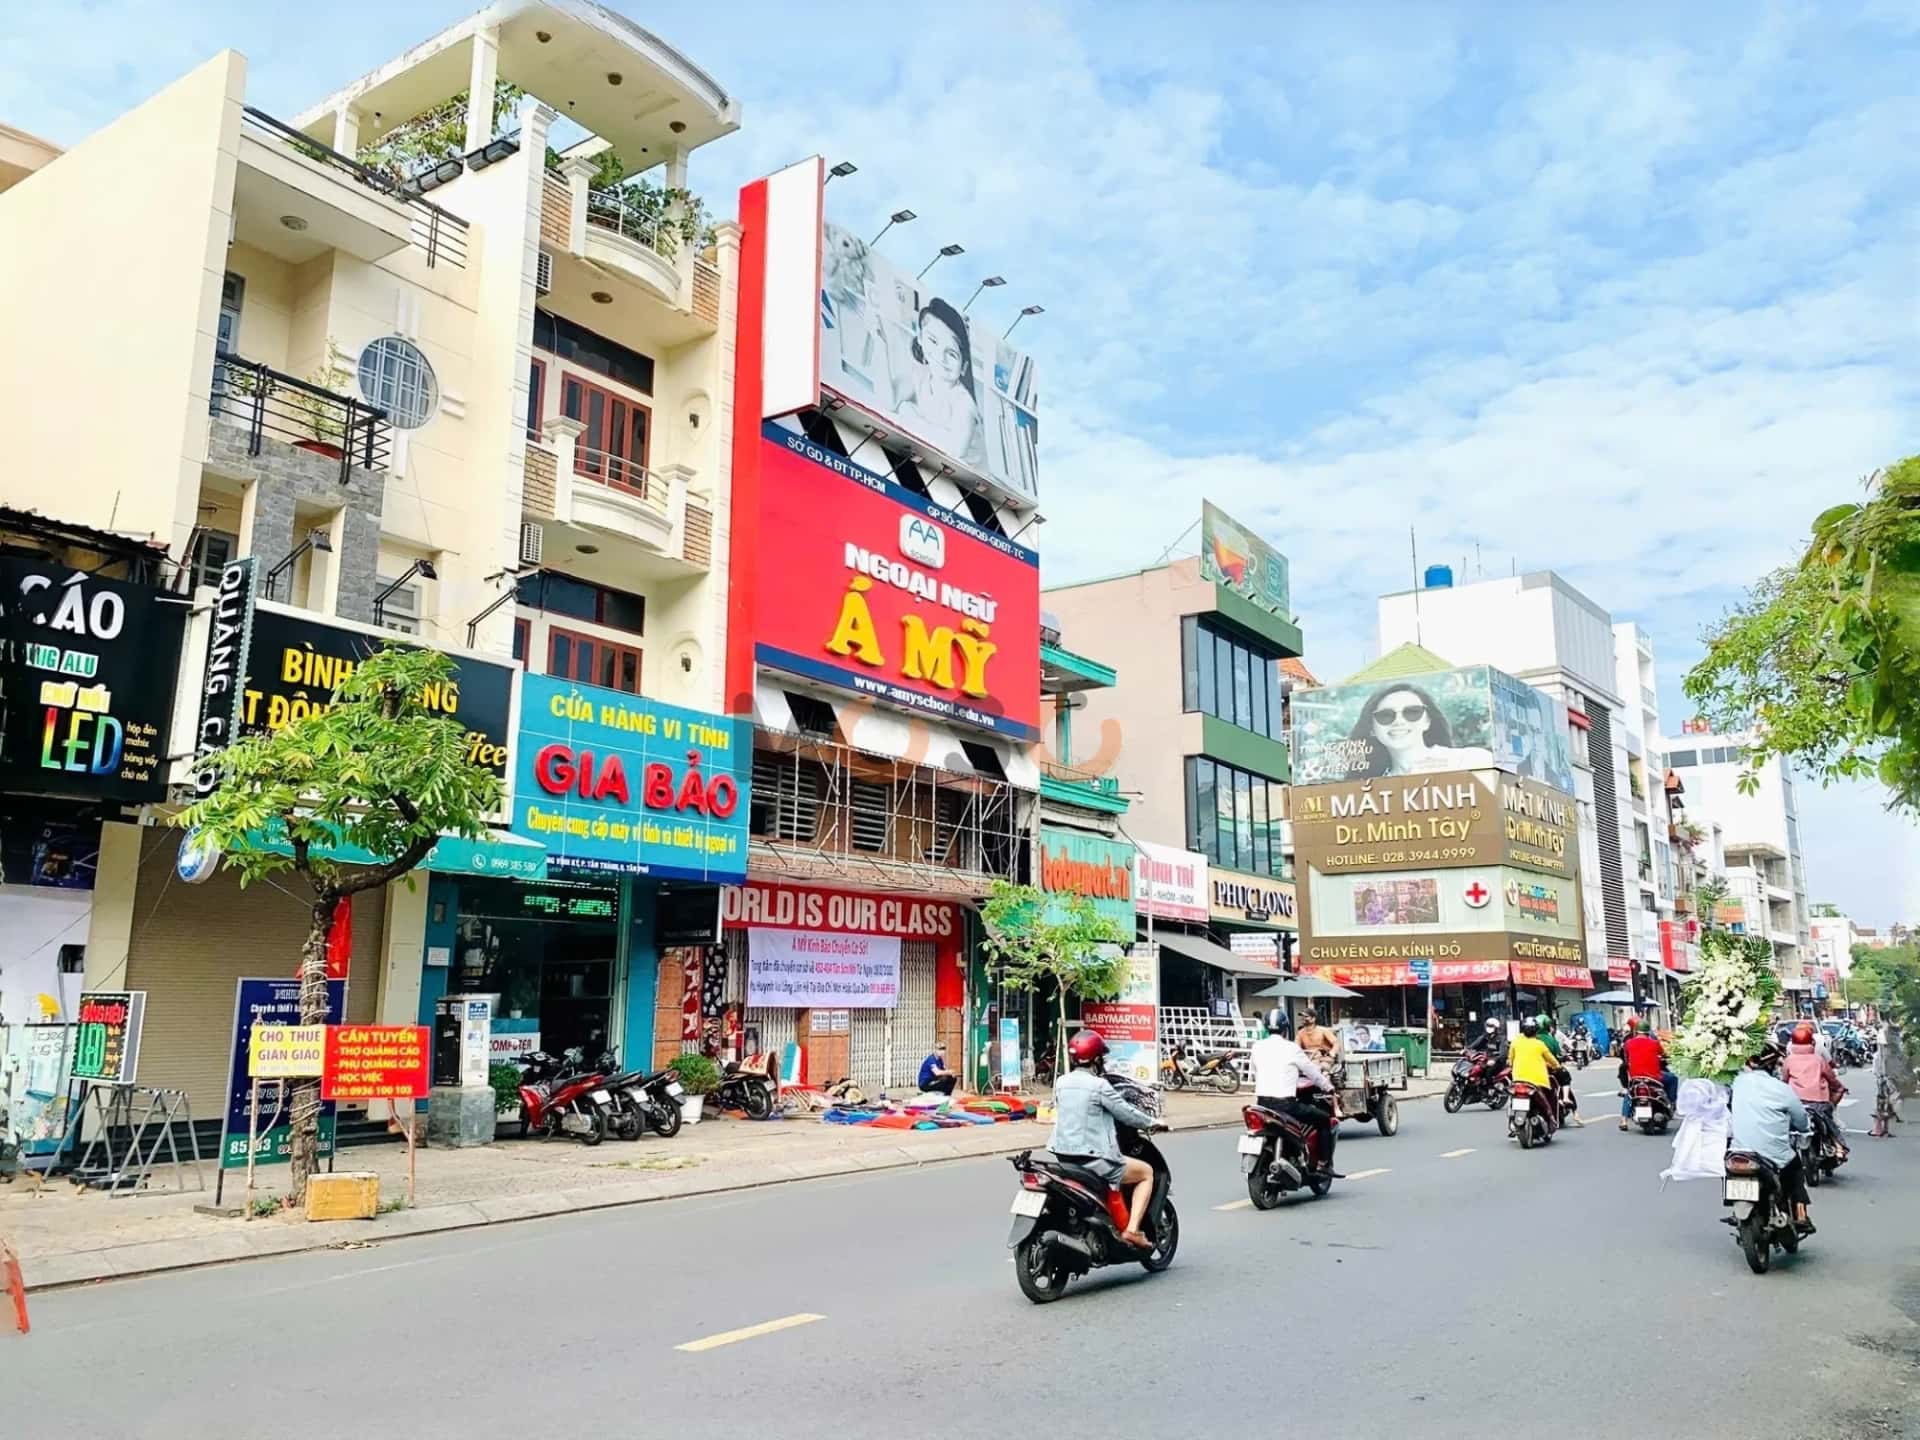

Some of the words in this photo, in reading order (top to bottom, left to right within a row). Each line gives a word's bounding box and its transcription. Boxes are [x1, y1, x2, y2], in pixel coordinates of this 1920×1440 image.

[806, 446, 823, 462] GD
[824, 456, 832, 468] &
[833, 461, 848, 474] ĐT
[849, 467, 887, 494] TP.HCM
[844, 542, 938, 604] NGOẠI
[940, 590, 998, 624] NGỮ
[207, 564, 243, 696] QUẢNG
[59, 649, 99, 678] ALU
[283, 641, 355, 690] BÌNH
[900, 614, 998, 698] MỸ
[550, 688, 594, 724] CỬA
[600, 702, 657, 737] HÀNG
[662, 720, 681, 741] VI
[687, 719, 730, 750] TÍNH
[853, 675, 996, 728] www.amyschool.edu.vn
[40, 706, 123, 775] LED
[534, 744, 630, 805] GIA
[643, 747, 739, 820] BẢO
[1330, 778, 1394, 819] MẮT
[1402, 778, 1478, 813] KÍNH
[1502, 775, 1534, 818] MẮT
[1536, 790, 1565, 827] KÍNH
[527, 805, 564, 835] Chuyên
[591, 813, 609, 841] cấp
[643, 817, 661, 844] tính
[1336, 823, 1364, 846] Dr.
[1367, 819, 1422, 843] Minh
[1427, 816, 1471, 842] Tây
[1326, 852, 1380, 867] HOTLINE:
[1383, 847, 1477, 864] 028.3944.9999
[722, 886, 795, 926] ORLD
[798, 892, 823, 928] IS
[828, 895, 877, 932] OUR
[880, 900, 953, 937] CLASS
[1310, 942, 1369, 959] CHUYÊN
[1372, 944, 1401, 958] GIA
[1402, 940, 1435, 957] KÍNH
[1439, 939, 1462, 958] ĐỘ
[260, 1031, 284, 1042] CHO
[399, 1046, 420, 1056] CÁO
[399, 1058, 420, 1068] CÁO
